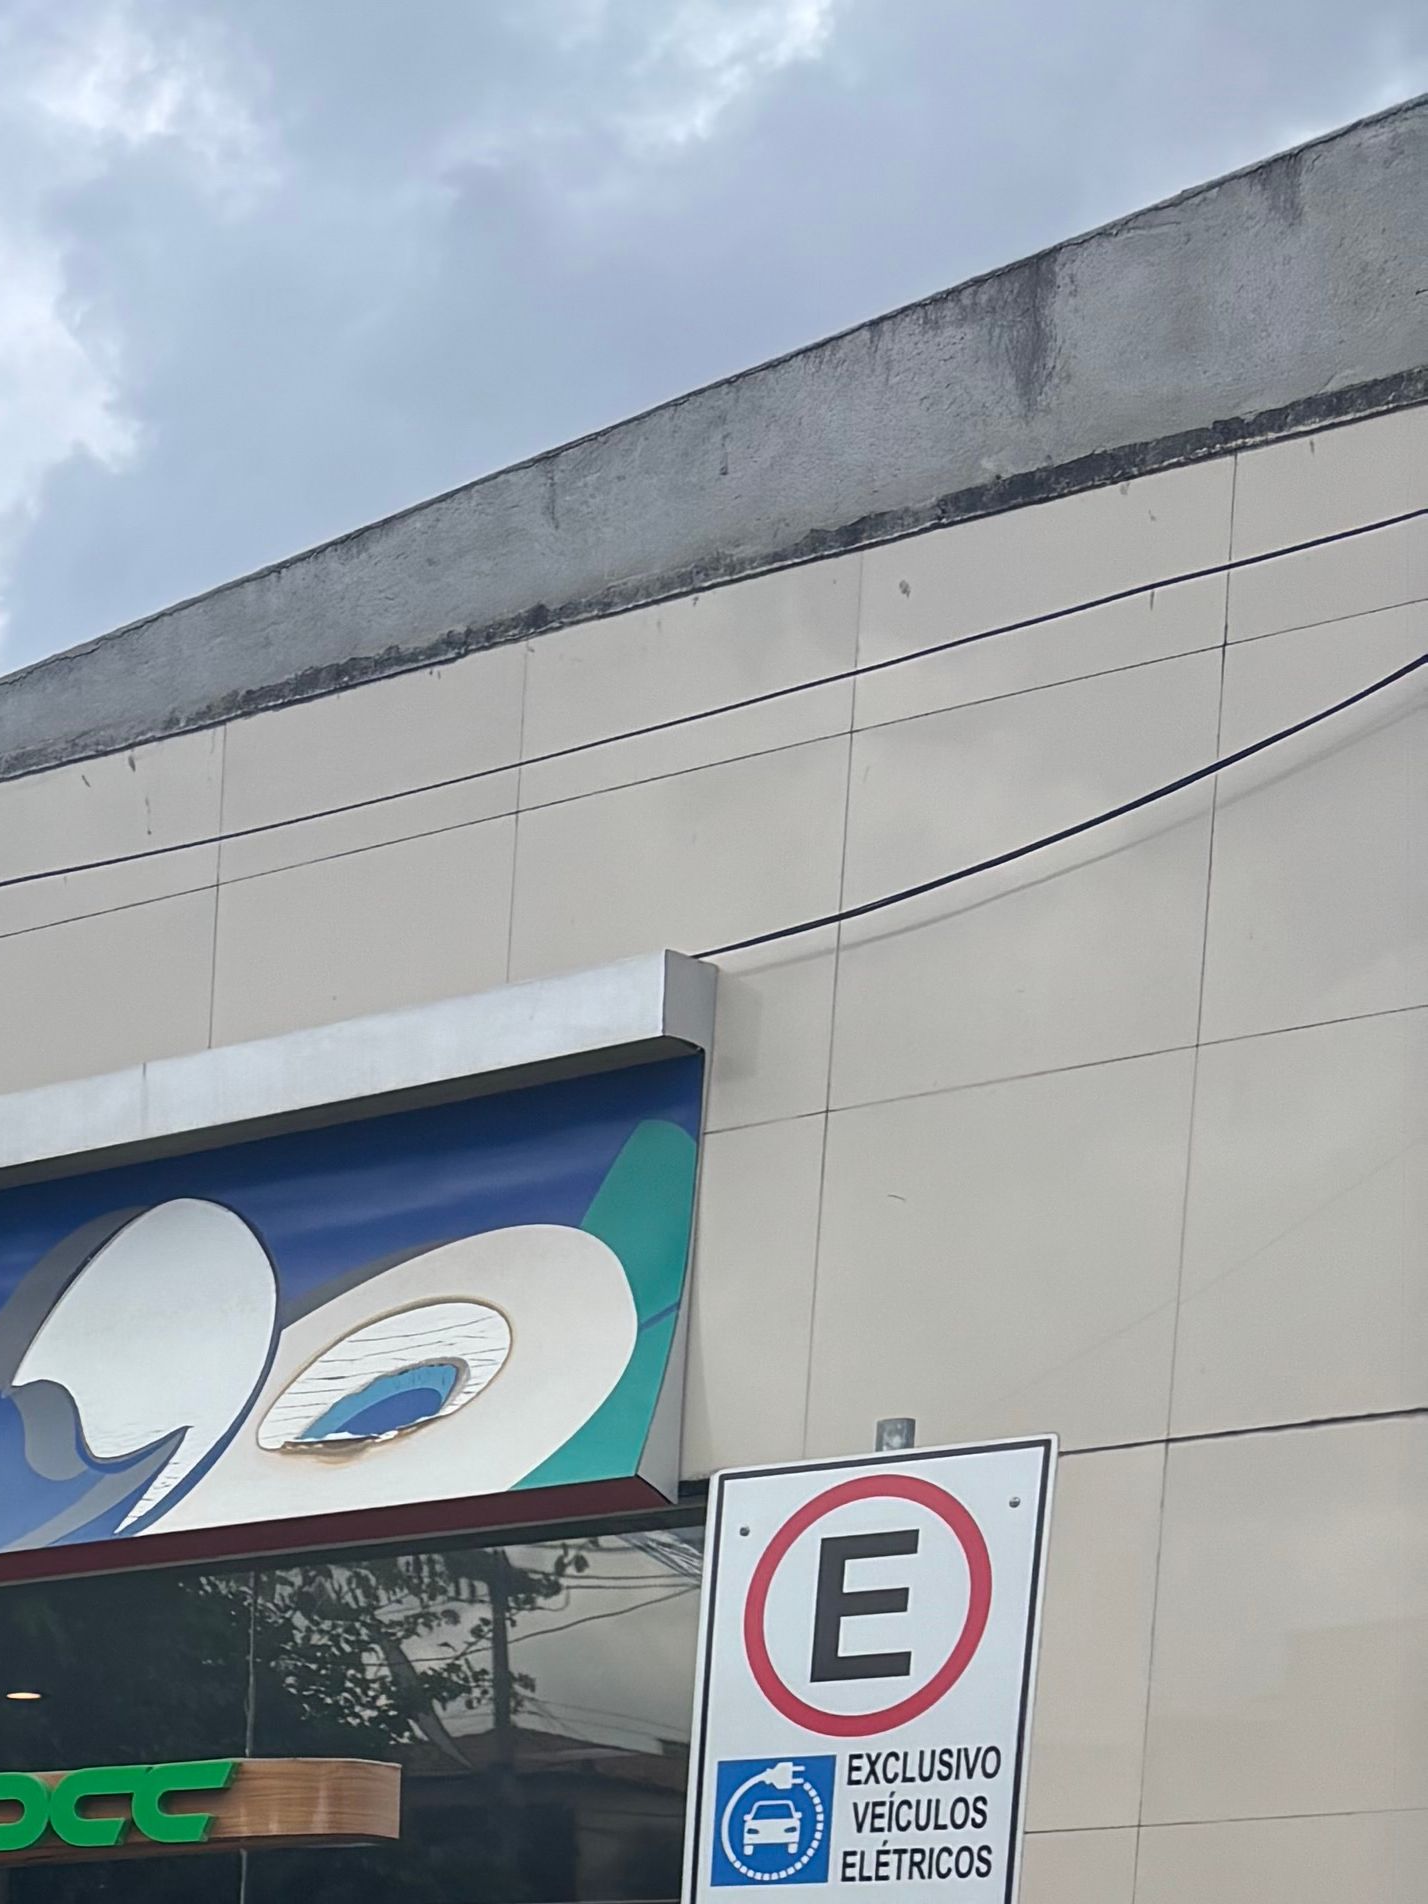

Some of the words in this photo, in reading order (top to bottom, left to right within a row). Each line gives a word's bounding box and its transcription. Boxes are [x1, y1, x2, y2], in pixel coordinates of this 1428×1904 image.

[810, 1529, 920, 1684] E
[845, 1746, 1002, 1787] EXCLUSIVO
[852, 1791, 988, 1834] VEÍCULOS
[841, 1840, 993, 1884] ELÉTRICOS
